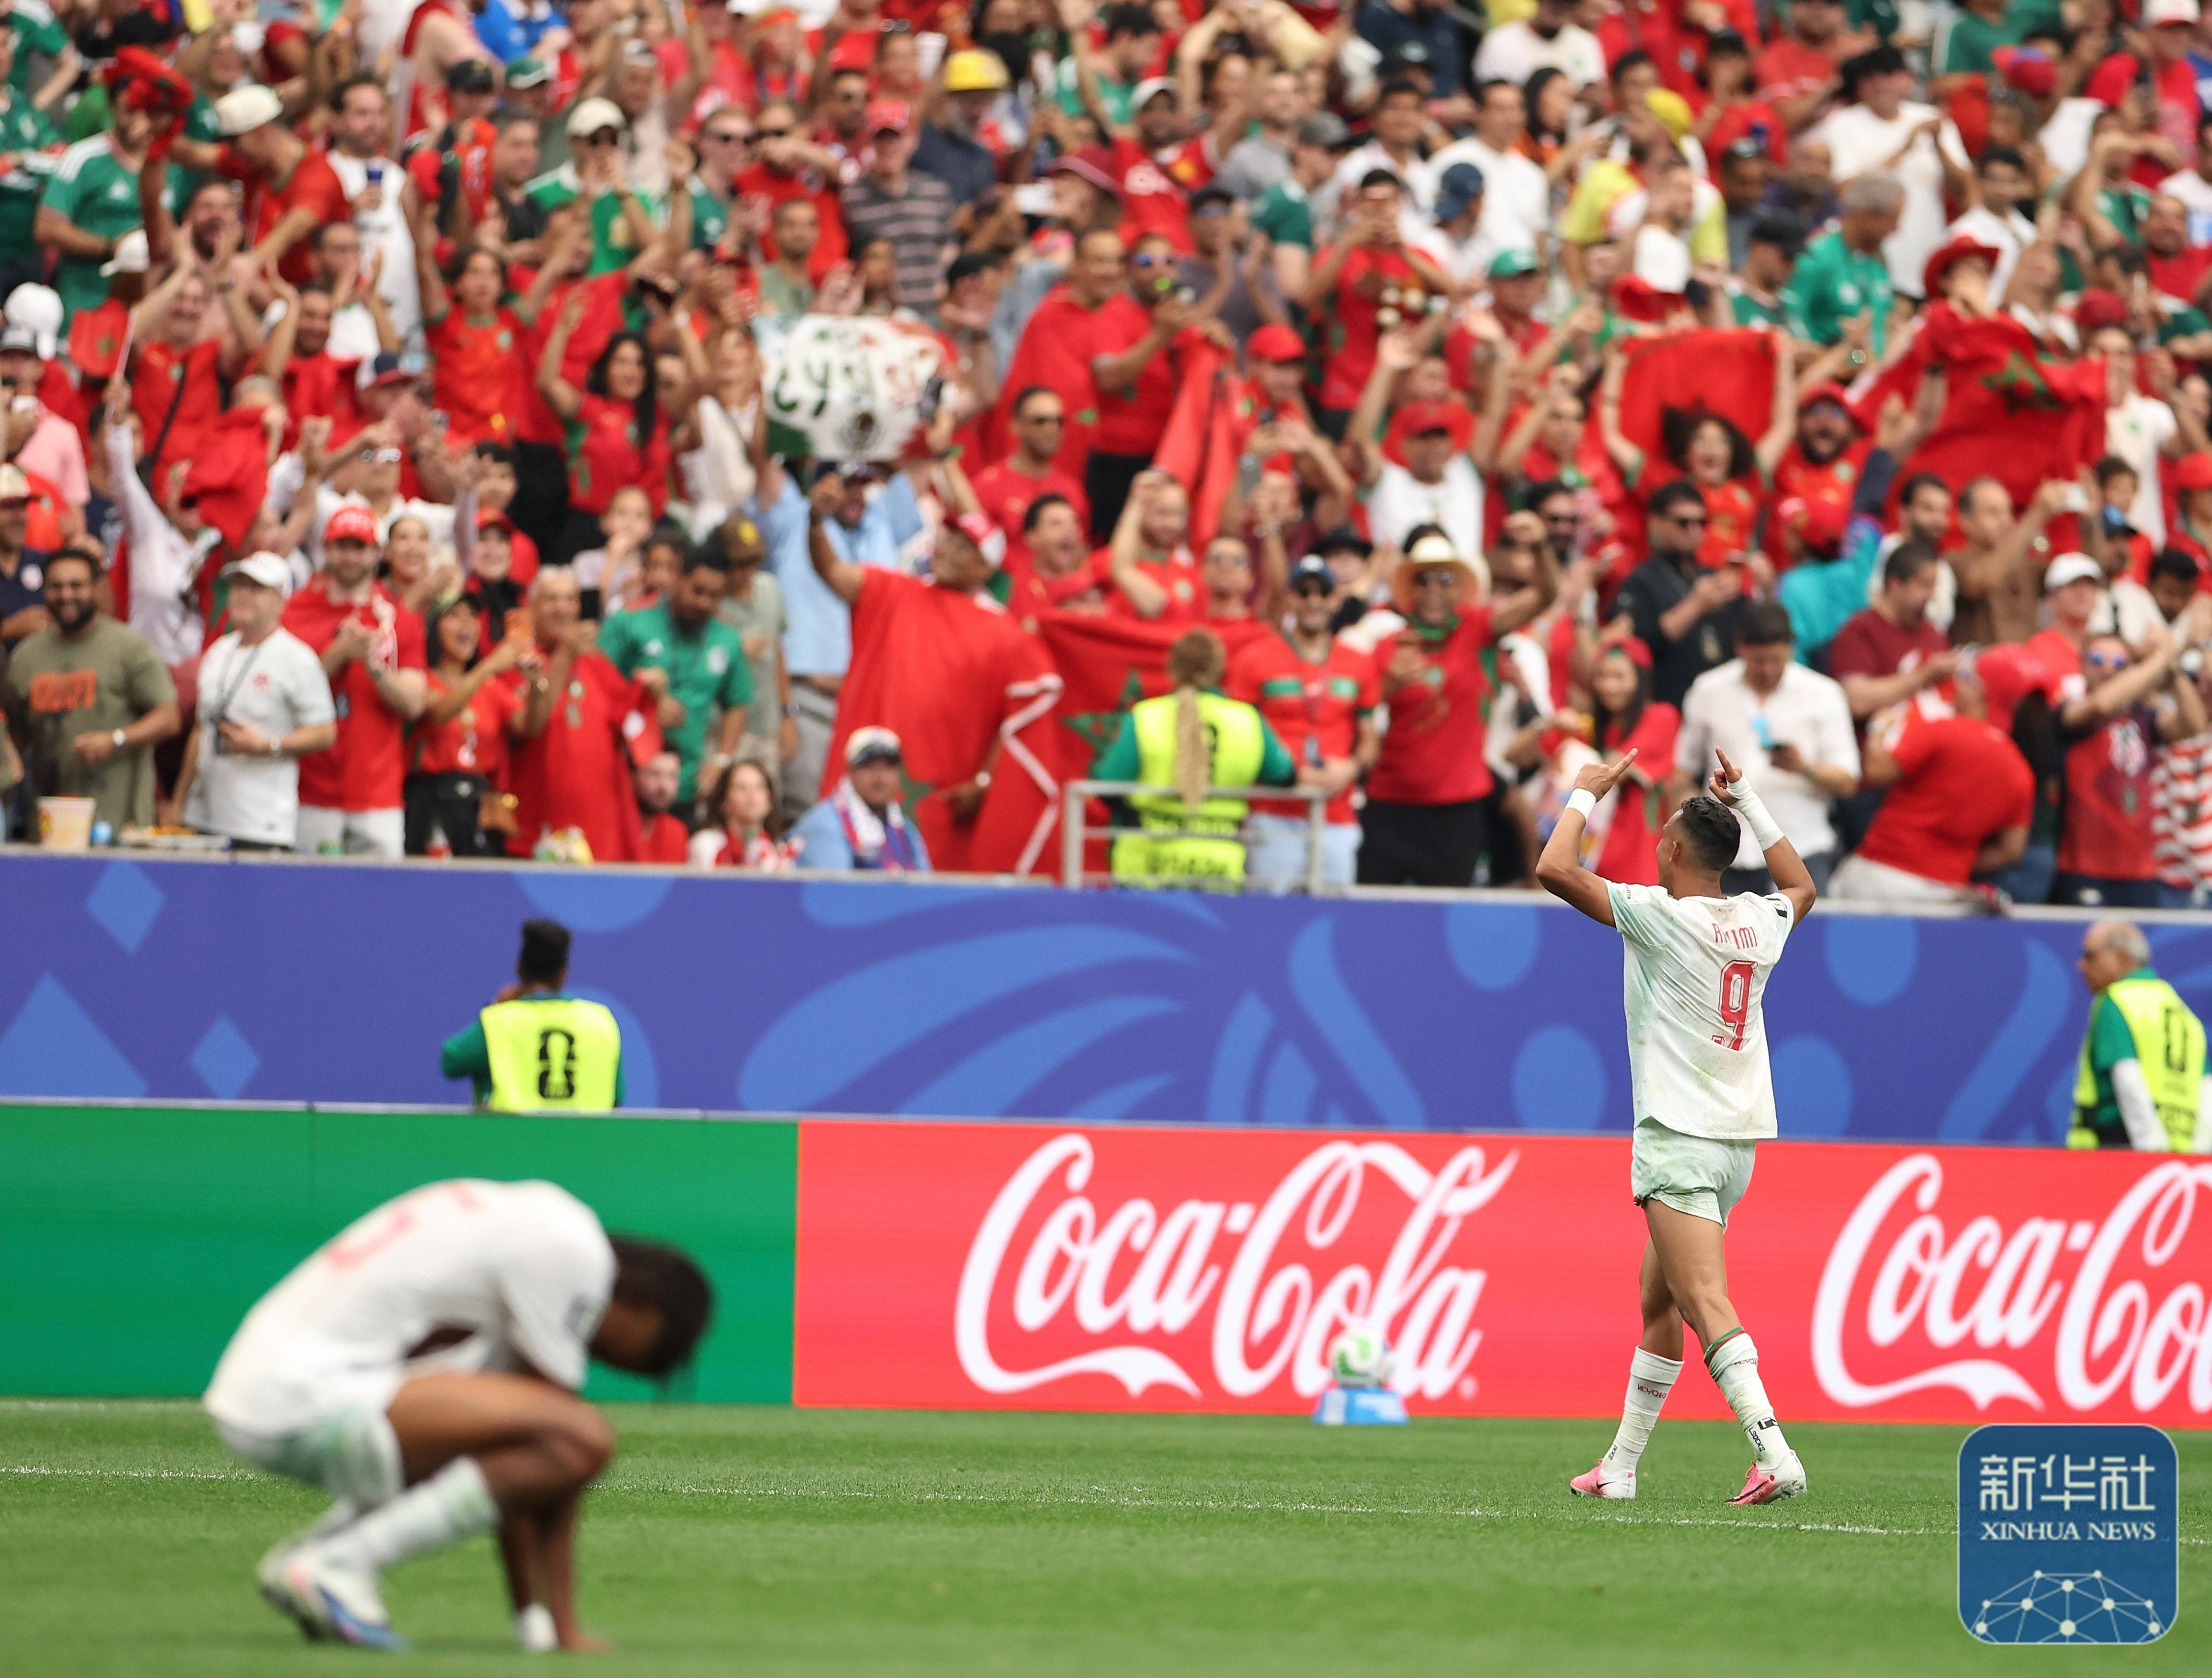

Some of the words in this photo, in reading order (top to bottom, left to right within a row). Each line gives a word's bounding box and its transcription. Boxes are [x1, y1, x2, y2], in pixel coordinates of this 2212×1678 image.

[1712, 959, 1759, 1051] 9
[954, 1133, 1520, 1399] Coca-Cola
[1811, 1153, 2212, 1413] Coca-Co
